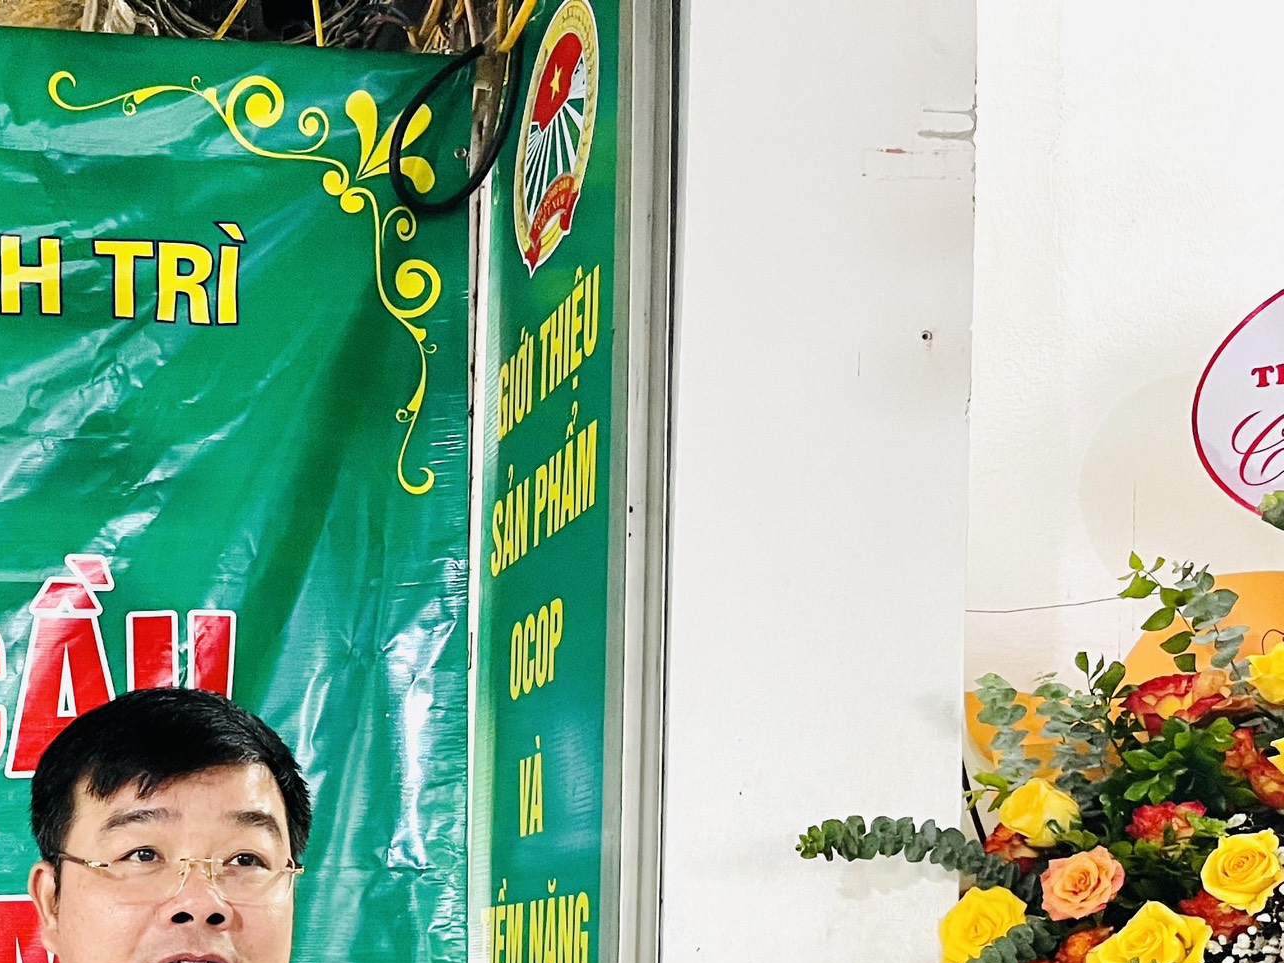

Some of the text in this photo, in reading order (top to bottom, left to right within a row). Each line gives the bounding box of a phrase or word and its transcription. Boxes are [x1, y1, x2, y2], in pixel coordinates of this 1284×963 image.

[93, 223, 248, 326] TRÌ
[496, 264, 601, 441] GIỚI THIỆU
[490, 401, 598, 577] SẢN PHẨM
[509, 597, 564, 701] OCOP
[518, 735, 545, 838] VÀ
